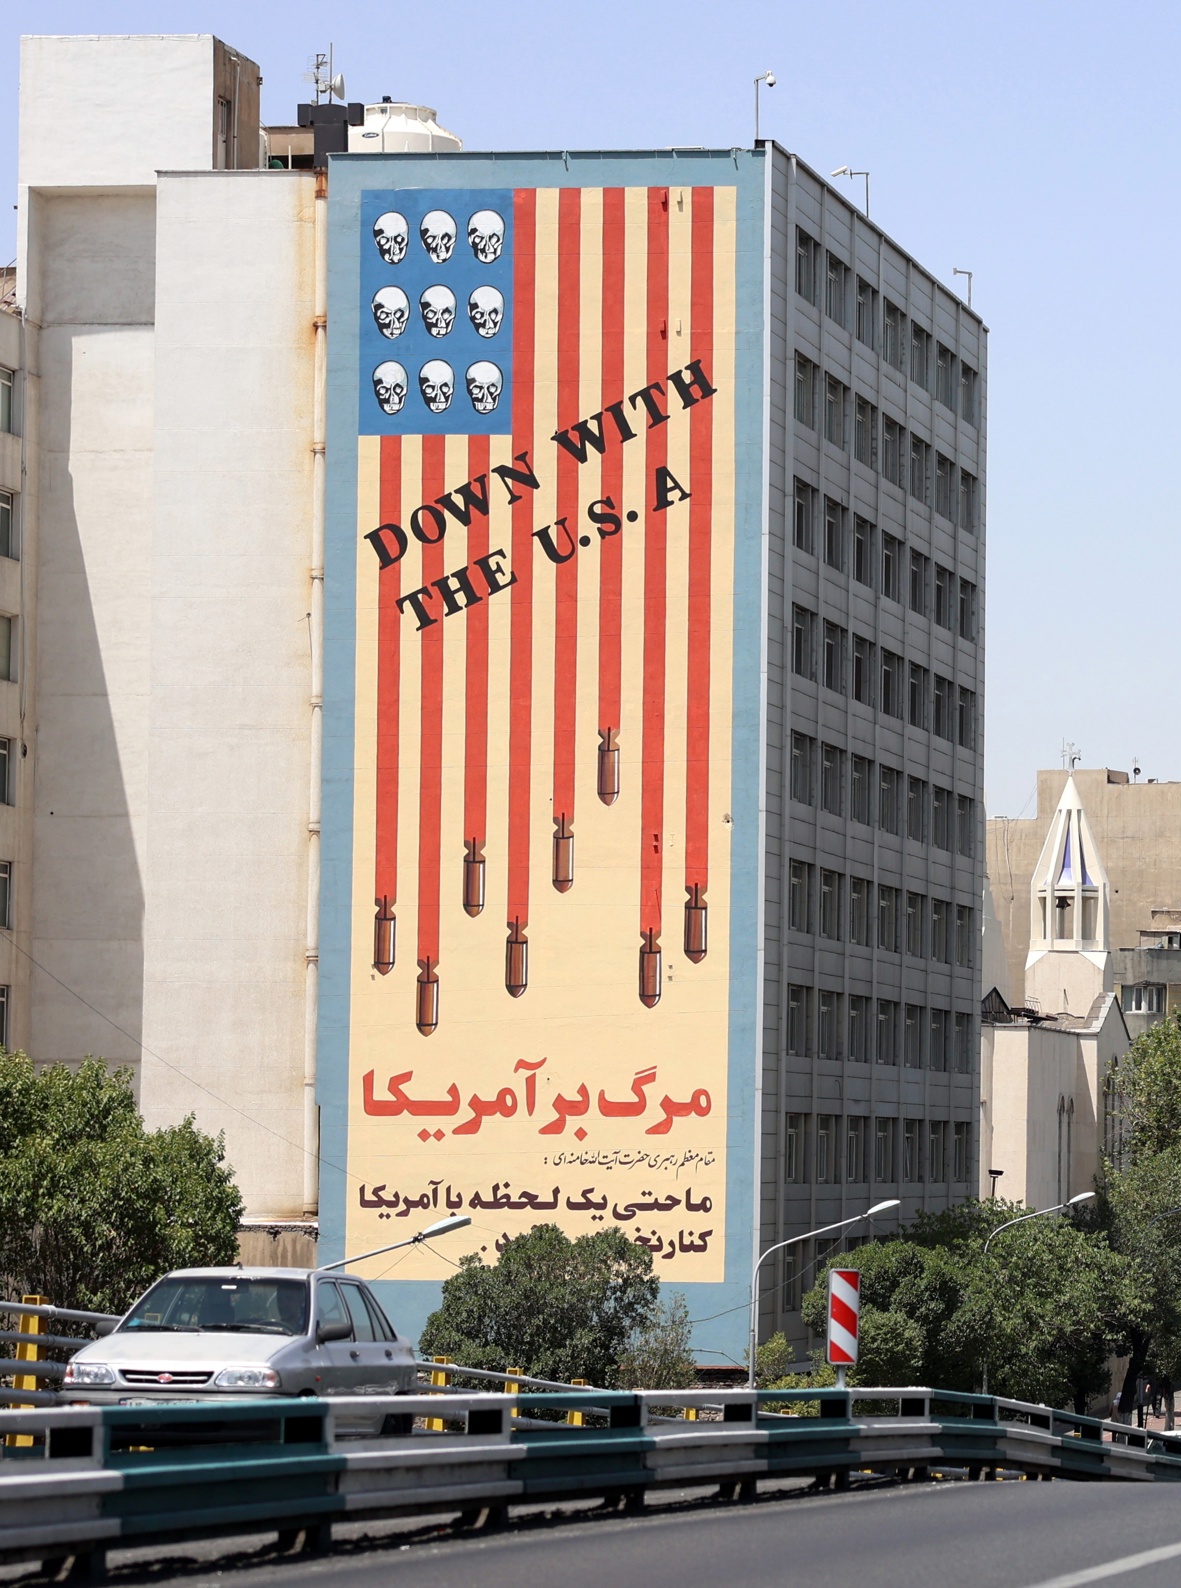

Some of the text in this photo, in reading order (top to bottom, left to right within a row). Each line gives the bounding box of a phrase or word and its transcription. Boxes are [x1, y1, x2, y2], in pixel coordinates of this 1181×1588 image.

[364, 359, 718, 570] DOWN WITH
[396, 549, 518, 632] THE
[362, 1057, 712, 1142] مرگ بر آمریکا
[618, 1150, 651, 1170] حضرت
[647, 1154, 679, 1170] رهبری
[676, 1149, 700, 1180] معظم
[695, 1151, 716, 1173] مقام
[359, 1178, 713, 1221] ما حتی یک لحظه با آمریکا
[661, 1229, 714, 1260] کنار
